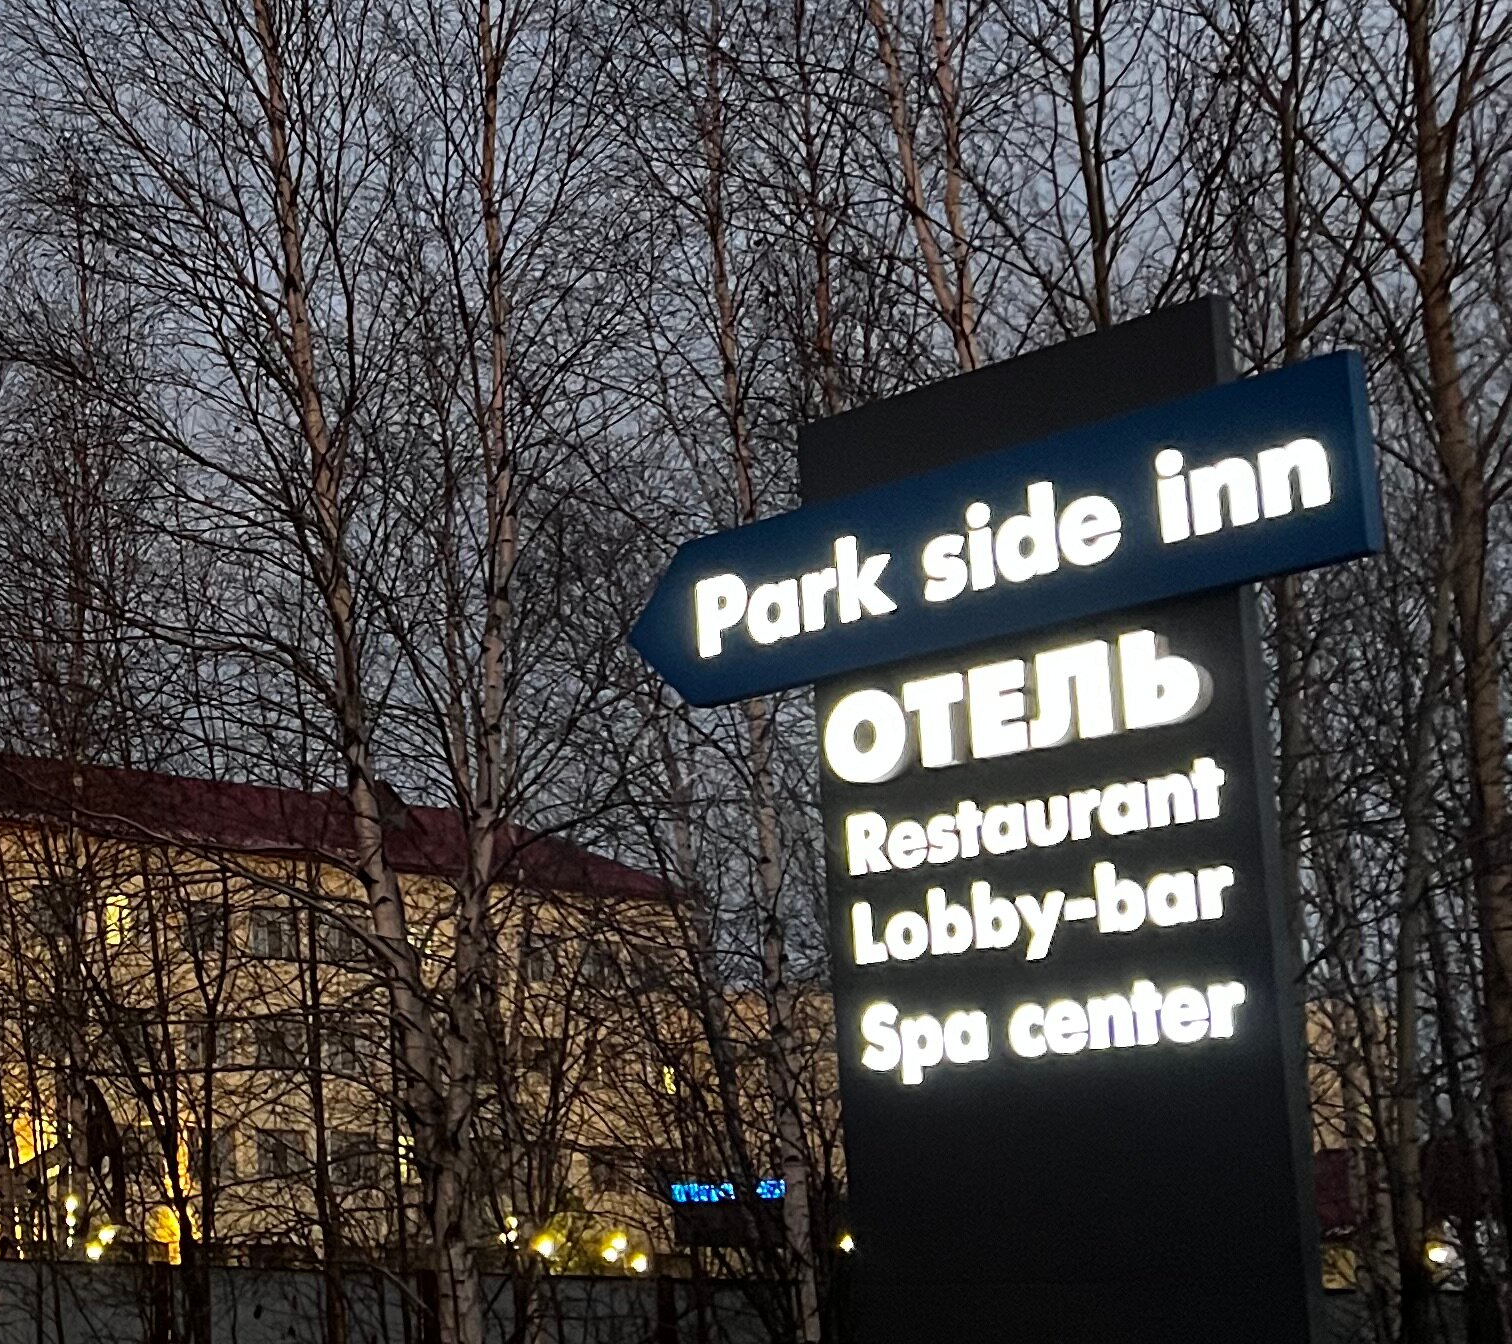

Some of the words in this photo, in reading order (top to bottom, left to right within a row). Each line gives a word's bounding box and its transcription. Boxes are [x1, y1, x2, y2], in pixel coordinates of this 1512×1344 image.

[693, 534, 899, 661] Park
[920, 480, 1123, 604] side
[1153, 437, 1333, 545] inn
[822, 629, 1210, 785] ОТЕЛЬ
[844, 756, 1226, 877] Restaurant
[850, 860, 1236, 966] Lobby-bar
[859, 1001, 991, 1086] Spa
[1006, 978, 1247, 1059] center
